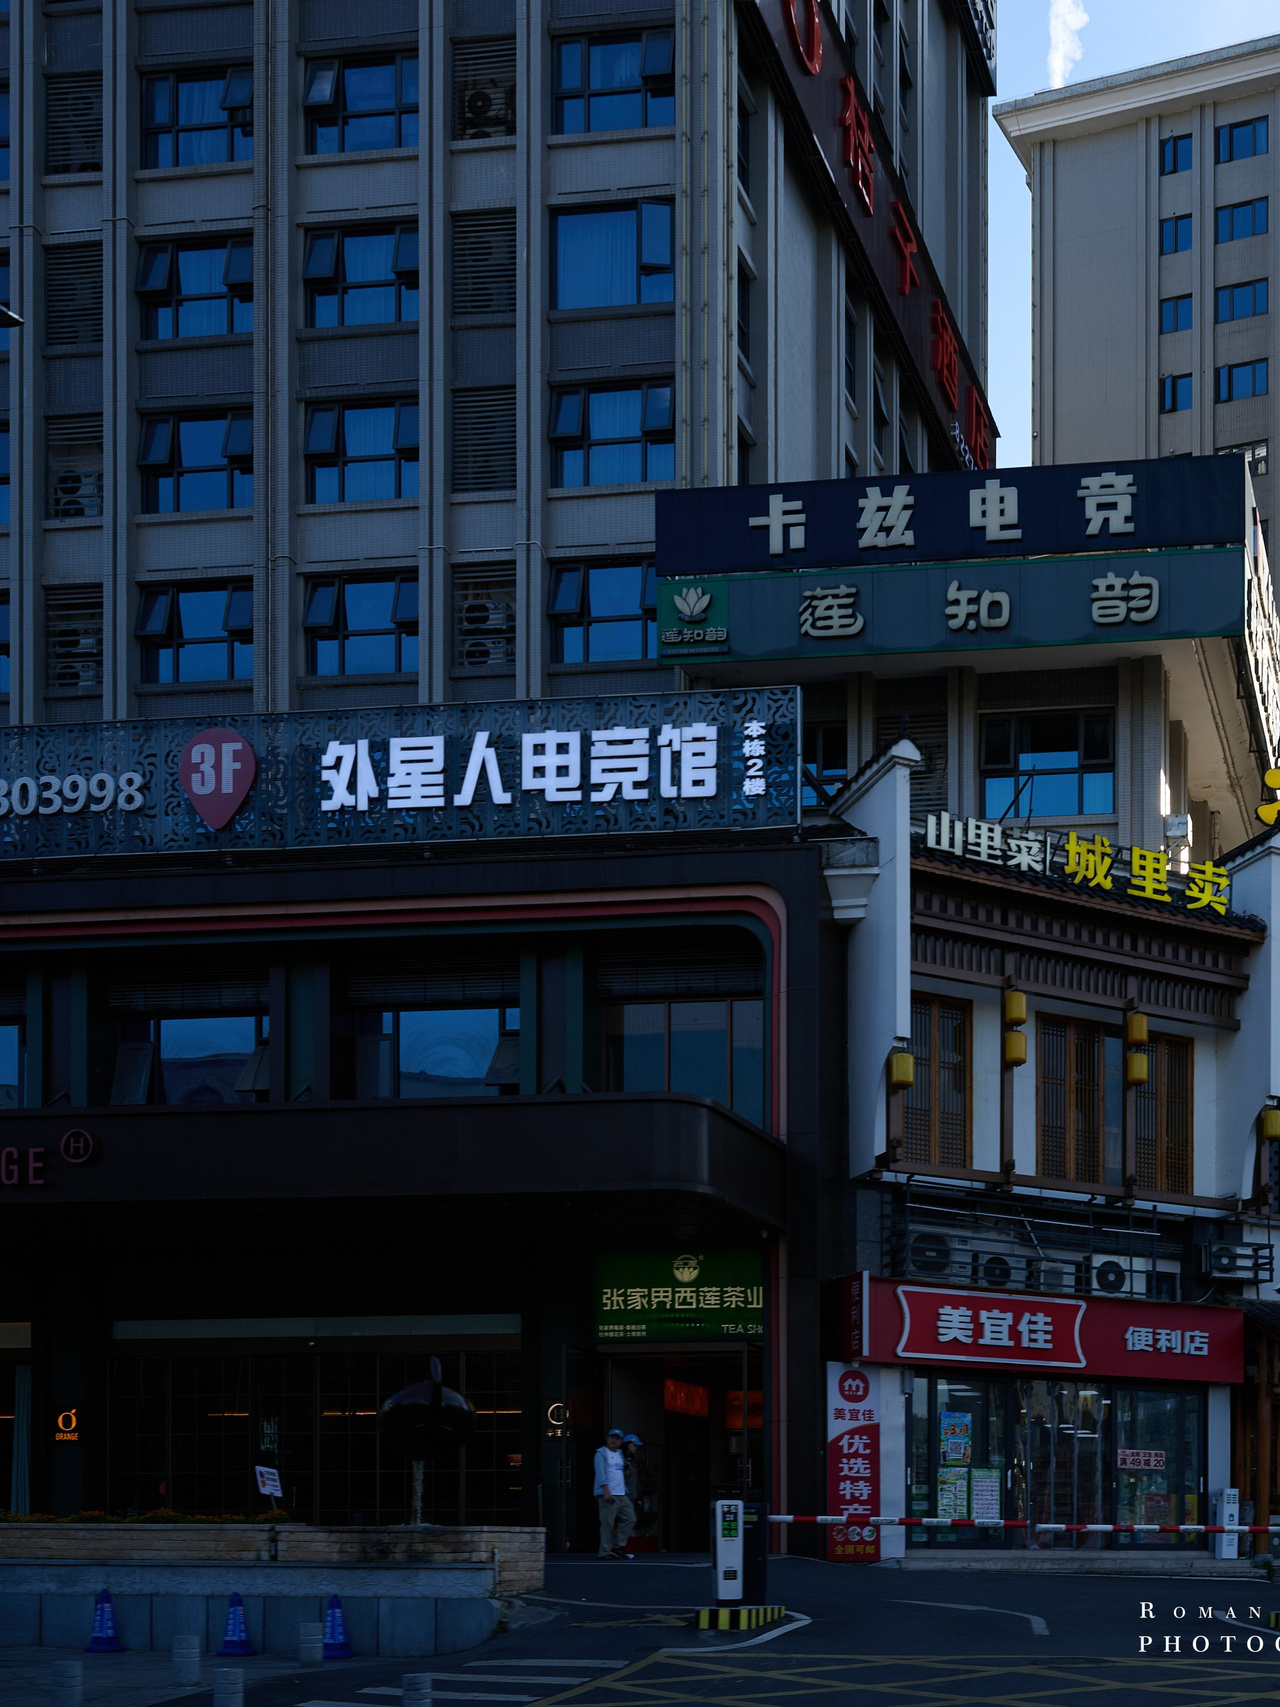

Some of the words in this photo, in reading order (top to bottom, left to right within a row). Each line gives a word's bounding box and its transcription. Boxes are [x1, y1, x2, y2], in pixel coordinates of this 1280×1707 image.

[748, 472, 1138, 556] 卡兹电竞
[799, 570, 1161, 638] 莲知韵
[190, 741, 244, 796] 3F
[320, 722, 718, 812] 外星人电竞馆
[741, 720, 767, 797] 本栋2楼
[925, 810, 1044, 873] 山里菜
[1063, 831, 1231, 916] 城里卖
[602, 1285, 764, 1311] 张家界西莲茶业
[721, 1323, 745, 1335] TEA
[845, 1279, 861, 1352] 便利店
[936, 1304, 1054, 1350] 美宜佳
[1123, 1325, 1210, 1357] 便利店
[55, 1432, 79, 1441] ORANGE
[832, 1407, 875, 1423] 美宜佳
[837, 1433, 872, 1516] 优选特产
